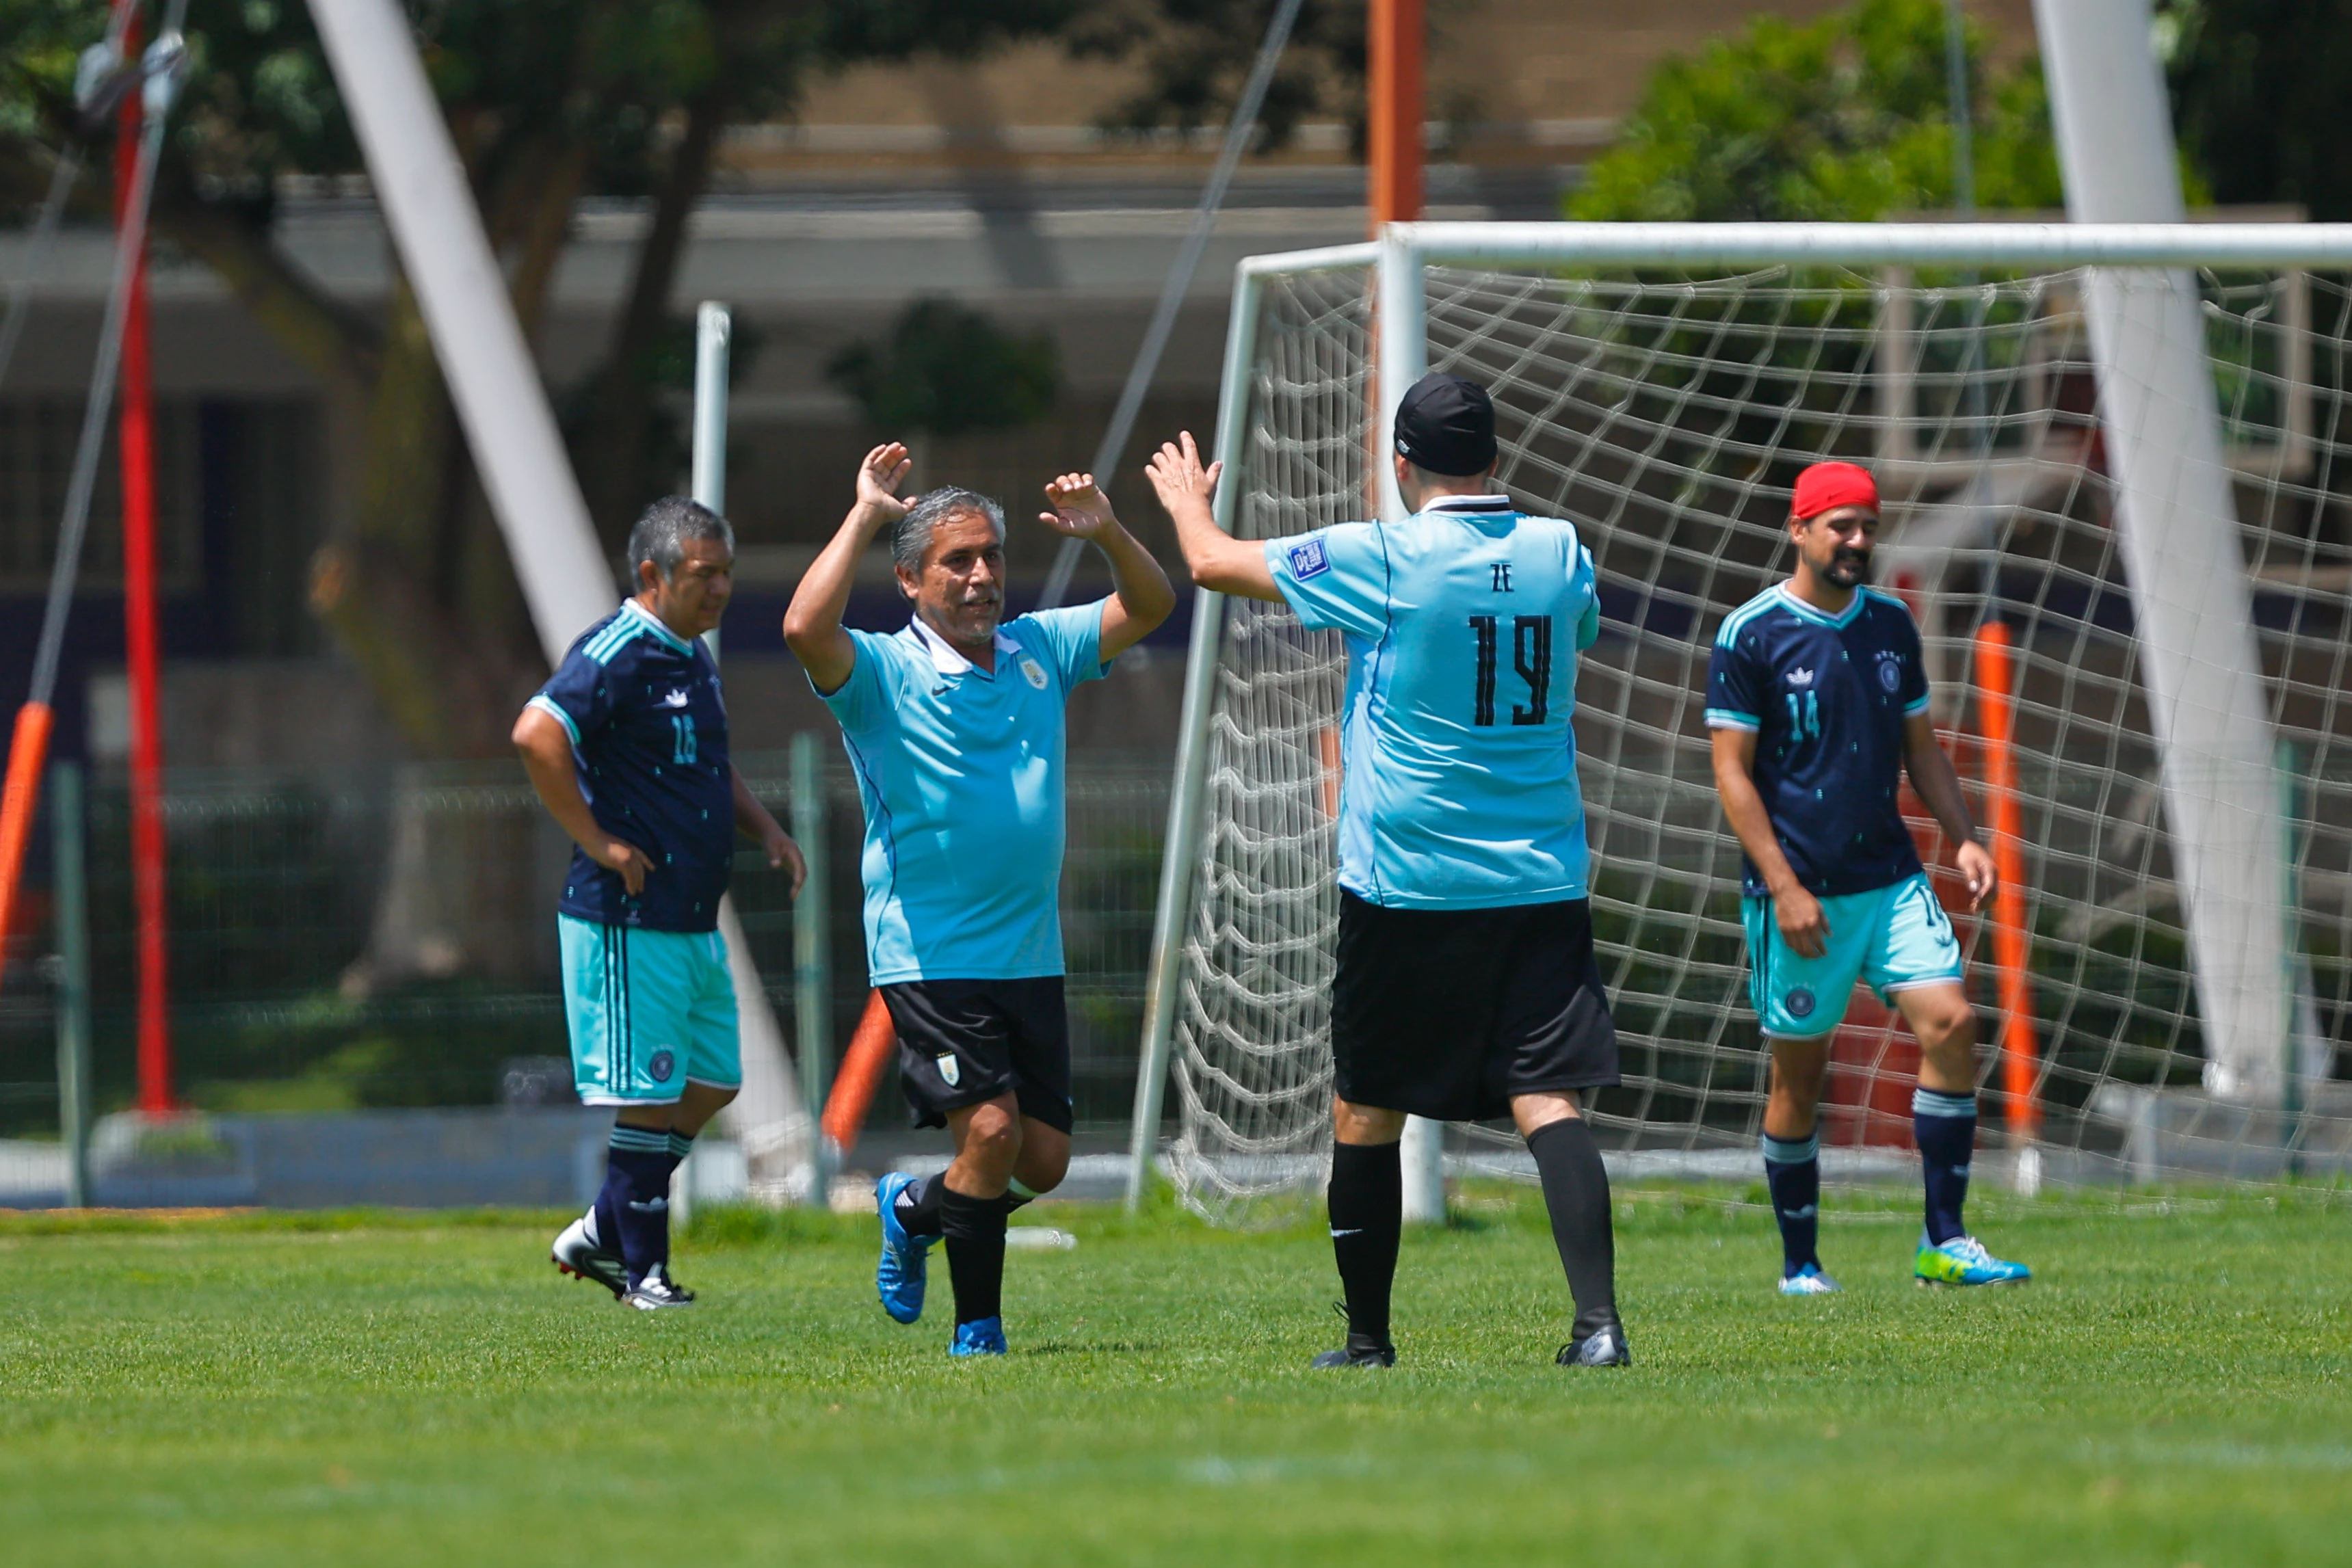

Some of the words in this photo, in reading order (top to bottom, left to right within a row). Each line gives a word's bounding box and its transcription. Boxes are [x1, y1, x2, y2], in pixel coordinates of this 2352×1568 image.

[1490, 563, 1515, 592] ZE
[1469, 615, 1552, 726] 19
[1786, 689, 1820, 743] 14
